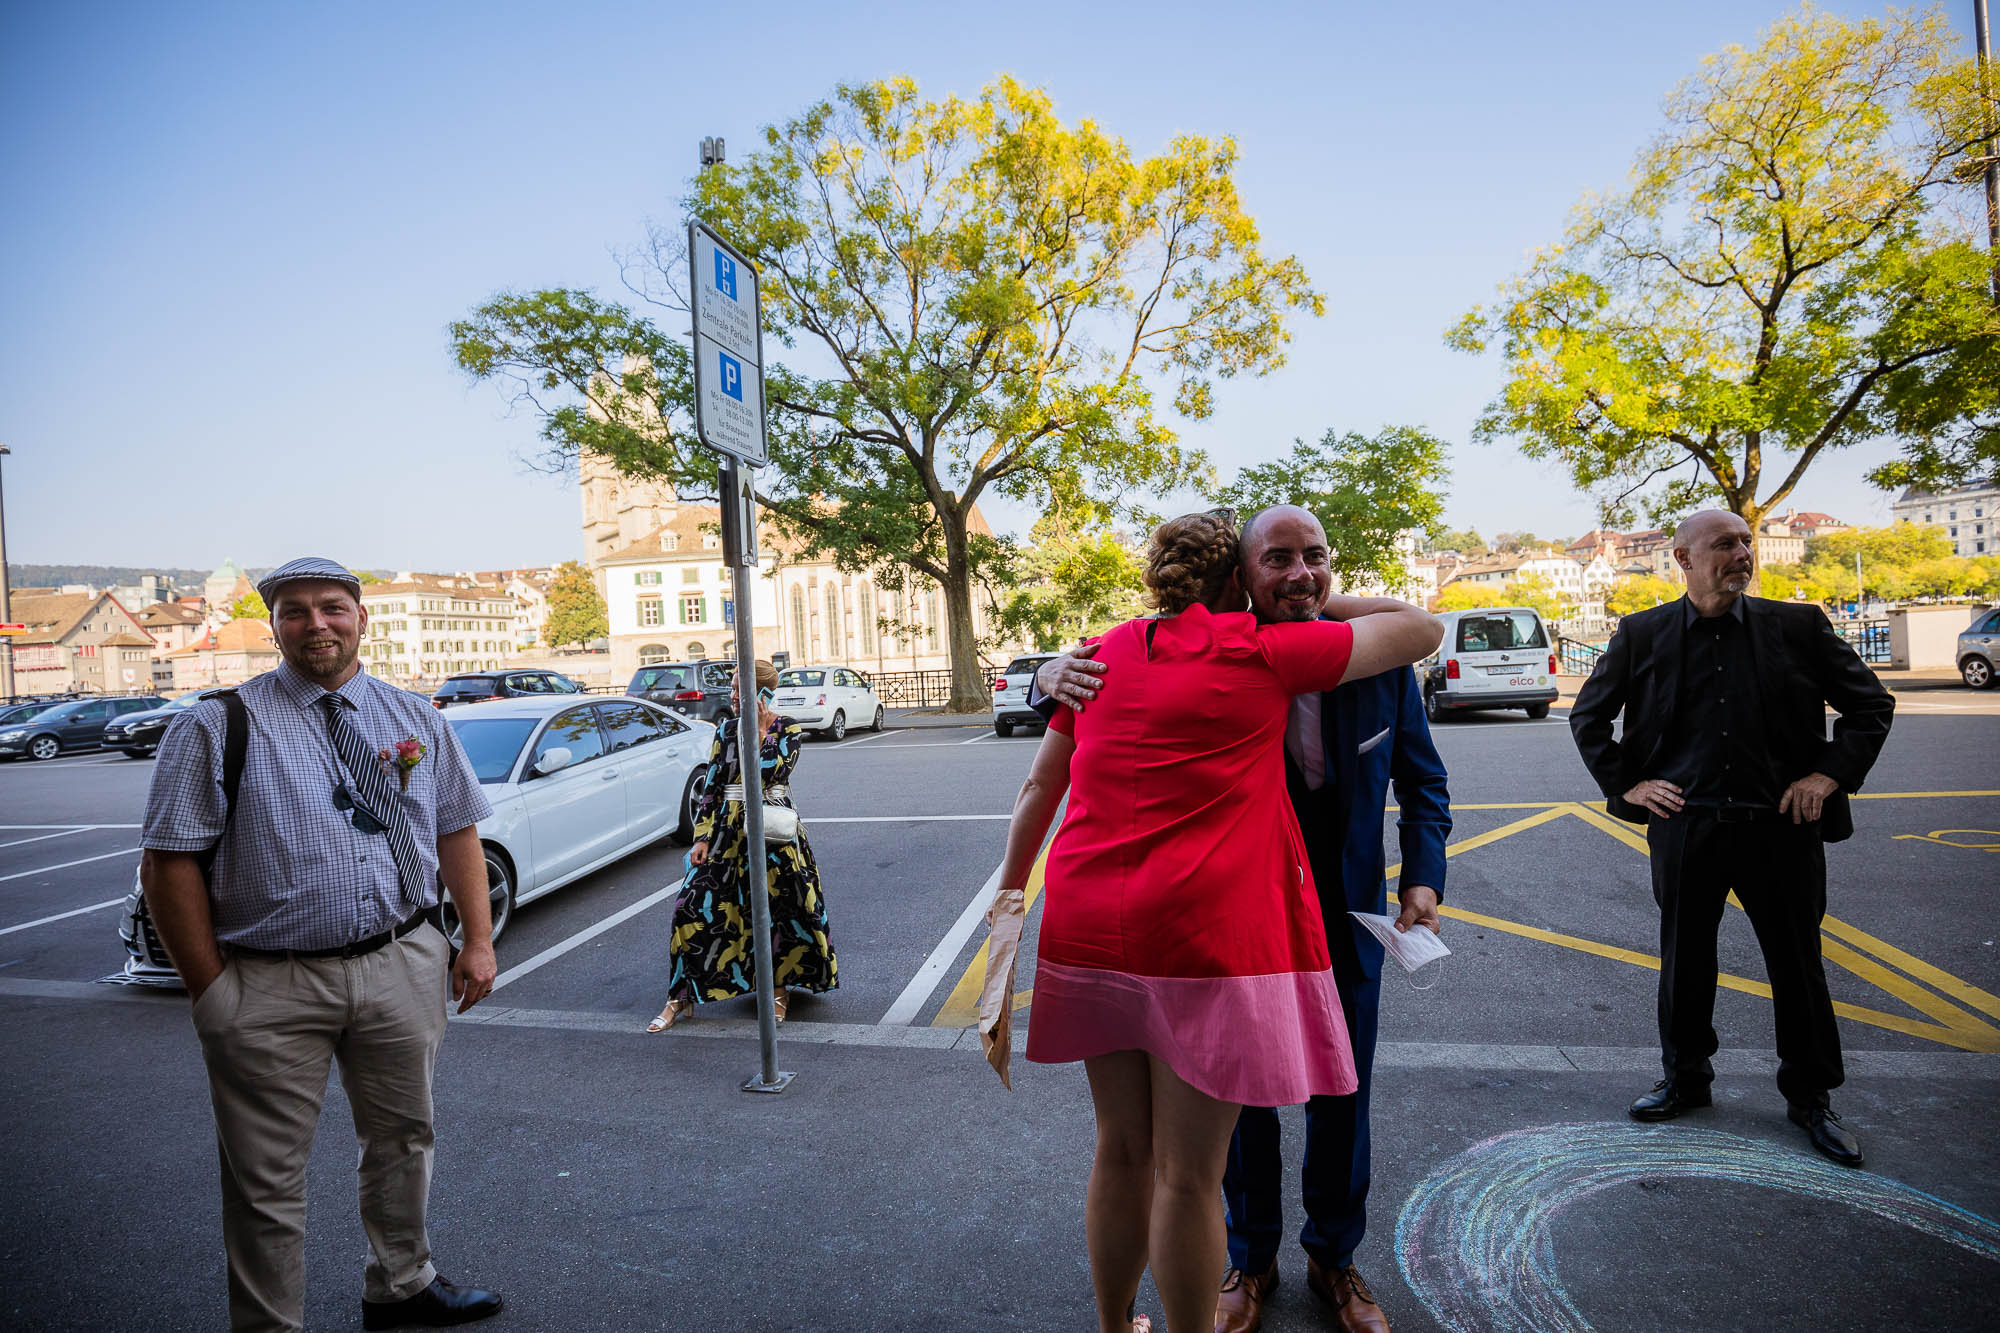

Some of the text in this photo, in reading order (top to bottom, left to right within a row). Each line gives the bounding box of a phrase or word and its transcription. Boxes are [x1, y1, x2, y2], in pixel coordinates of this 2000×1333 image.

[722, 257, 730, 277] P
[702, 306, 752, 345] Zentrale Parkuhr
[726, 360, 737, 392] P
[1509, 676, 1535, 686] elco
